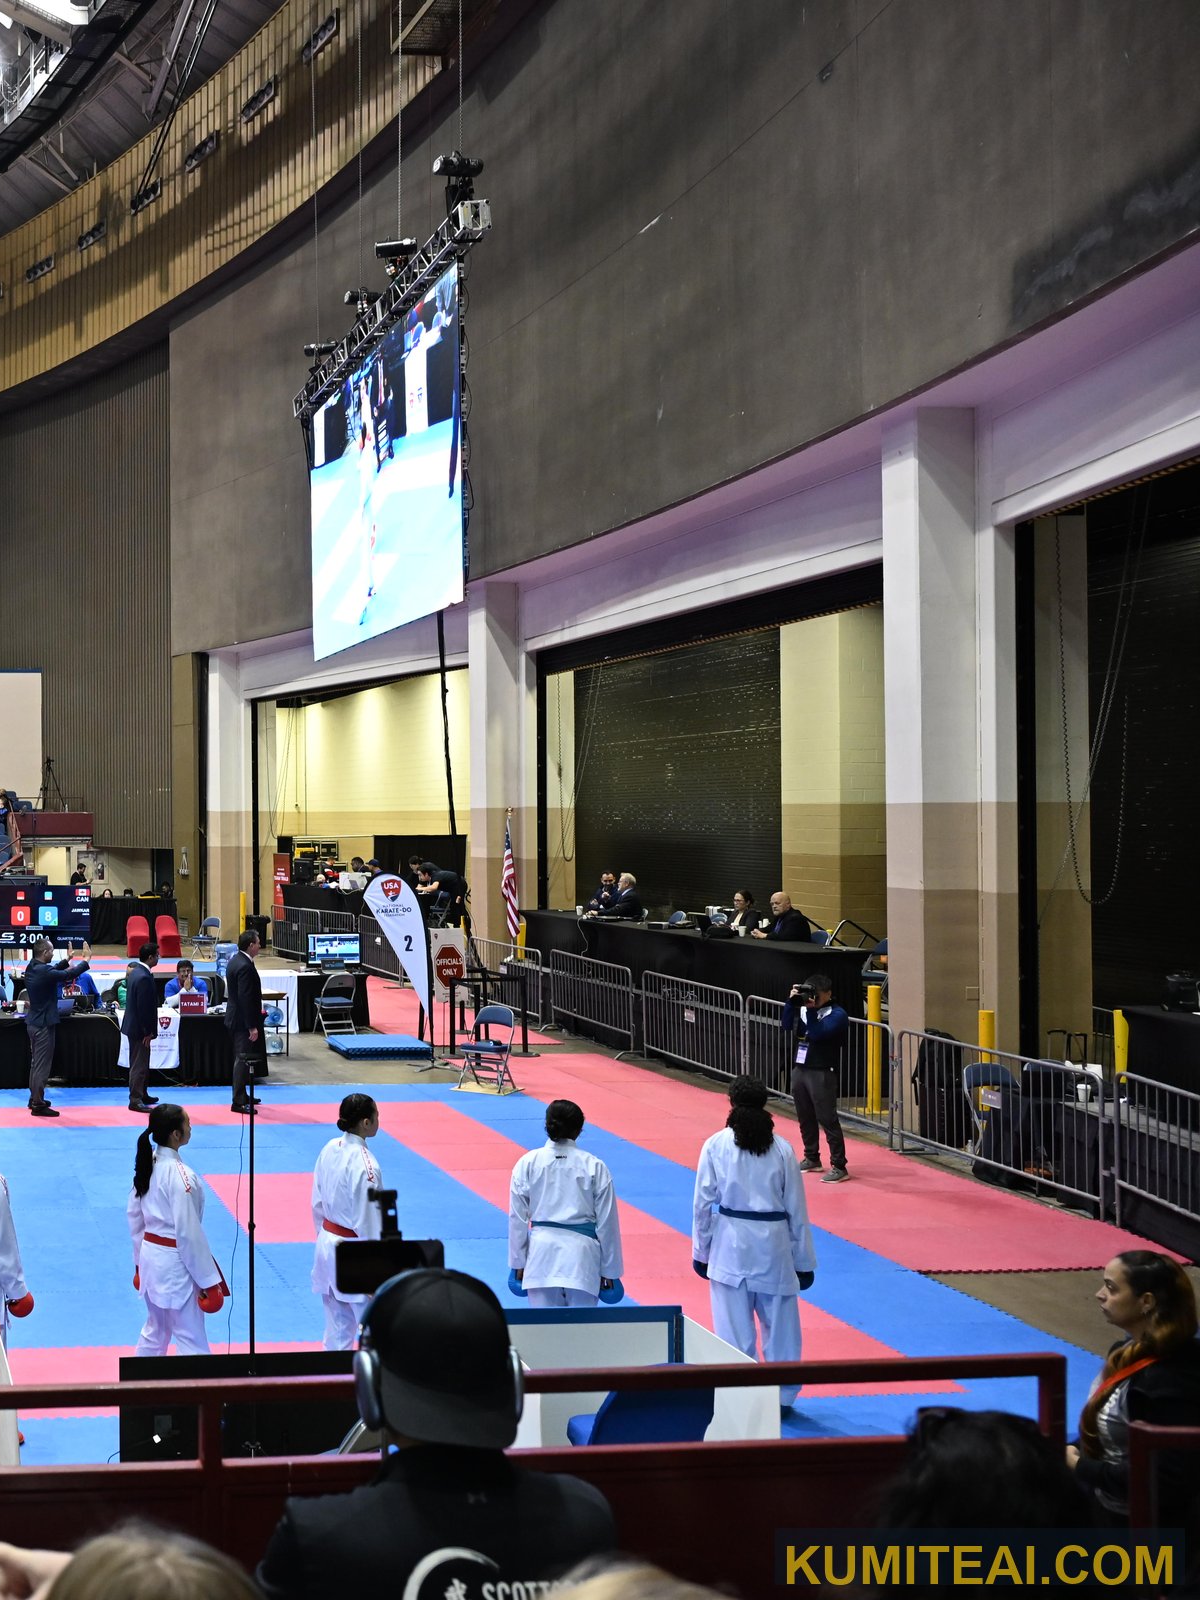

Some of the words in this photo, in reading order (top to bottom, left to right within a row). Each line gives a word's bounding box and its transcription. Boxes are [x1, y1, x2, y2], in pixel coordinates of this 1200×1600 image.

[383, 882, 399, 890] USA
[376, 906, 412, 914] KARATE-DO
[17, 911, 24, 921] 0
[44, 911, 52, 921] 8
[403, 935, 413, 952] 2
[436, 958, 462, 966] OFFICIALS
[442, 968, 457, 976] ONLY
